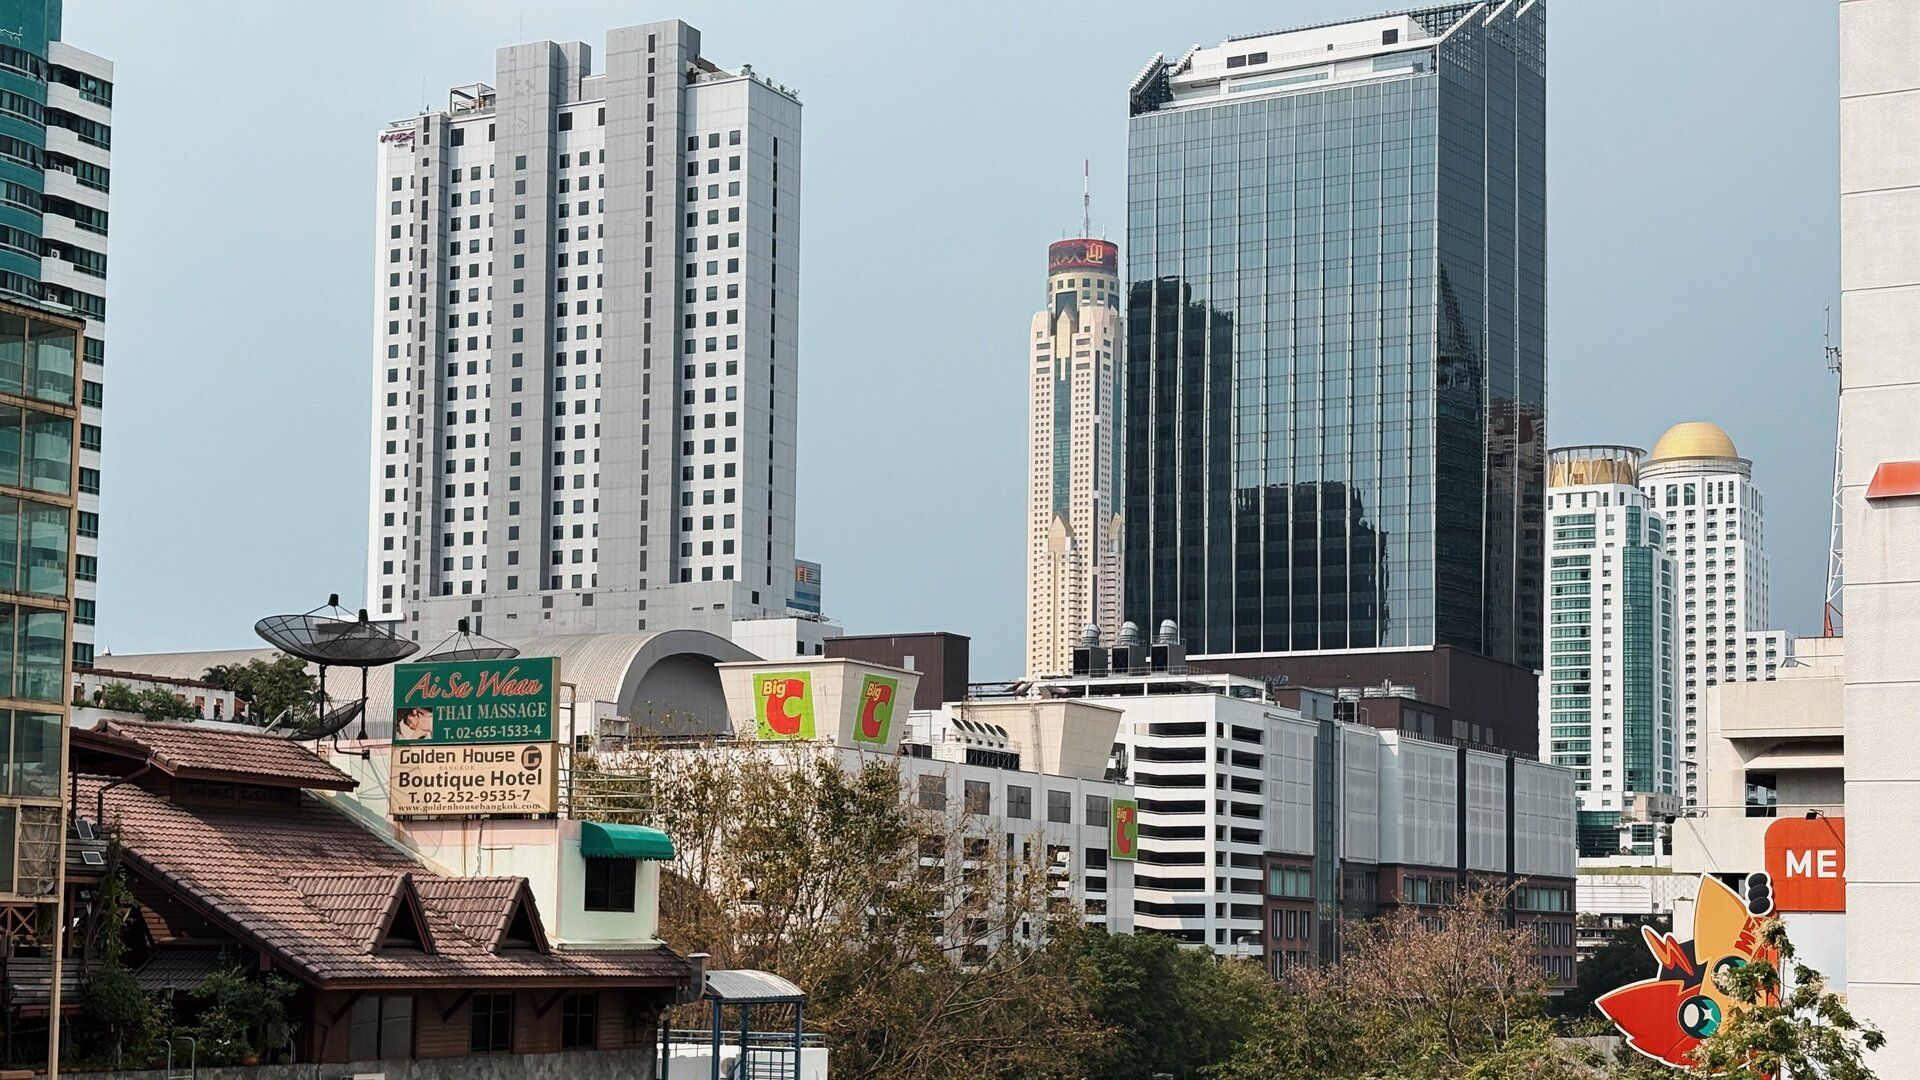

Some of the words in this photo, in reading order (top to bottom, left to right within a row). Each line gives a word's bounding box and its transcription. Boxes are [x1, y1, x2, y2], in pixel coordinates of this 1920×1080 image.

[405, 671, 442, 703] Ai
[442, 671, 474, 699] Sa
[476, 666, 544, 698] Waan
[762, 679, 787, 698] Big
[865, 681, 882, 701] Big
[436, 705, 472, 721] THAI
[477, 701, 547, 719] MASSAGE
[766, 678, 804, 735] C
[861, 684, 892, 738] C
[443, 727, 454, 739] T.
[456, 724, 542, 739] 02-655-1533-4
[400, 749, 455, 765] Golden
[463, 748, 515, 763] House
[399, 771, 485, 791] Boutique
[490, 768, 542, 787] Hotel
[409, 792, 420, 803] T.
[423, 789, 531, 803] 02-252-9535-7
[398, 803, 541, 812] www.goldenhousebangkok.com
[1116, 807, 1127, 823] Big
[1116, 807, 1134, 855] C
[1786, 849, 1845, 878] ME
